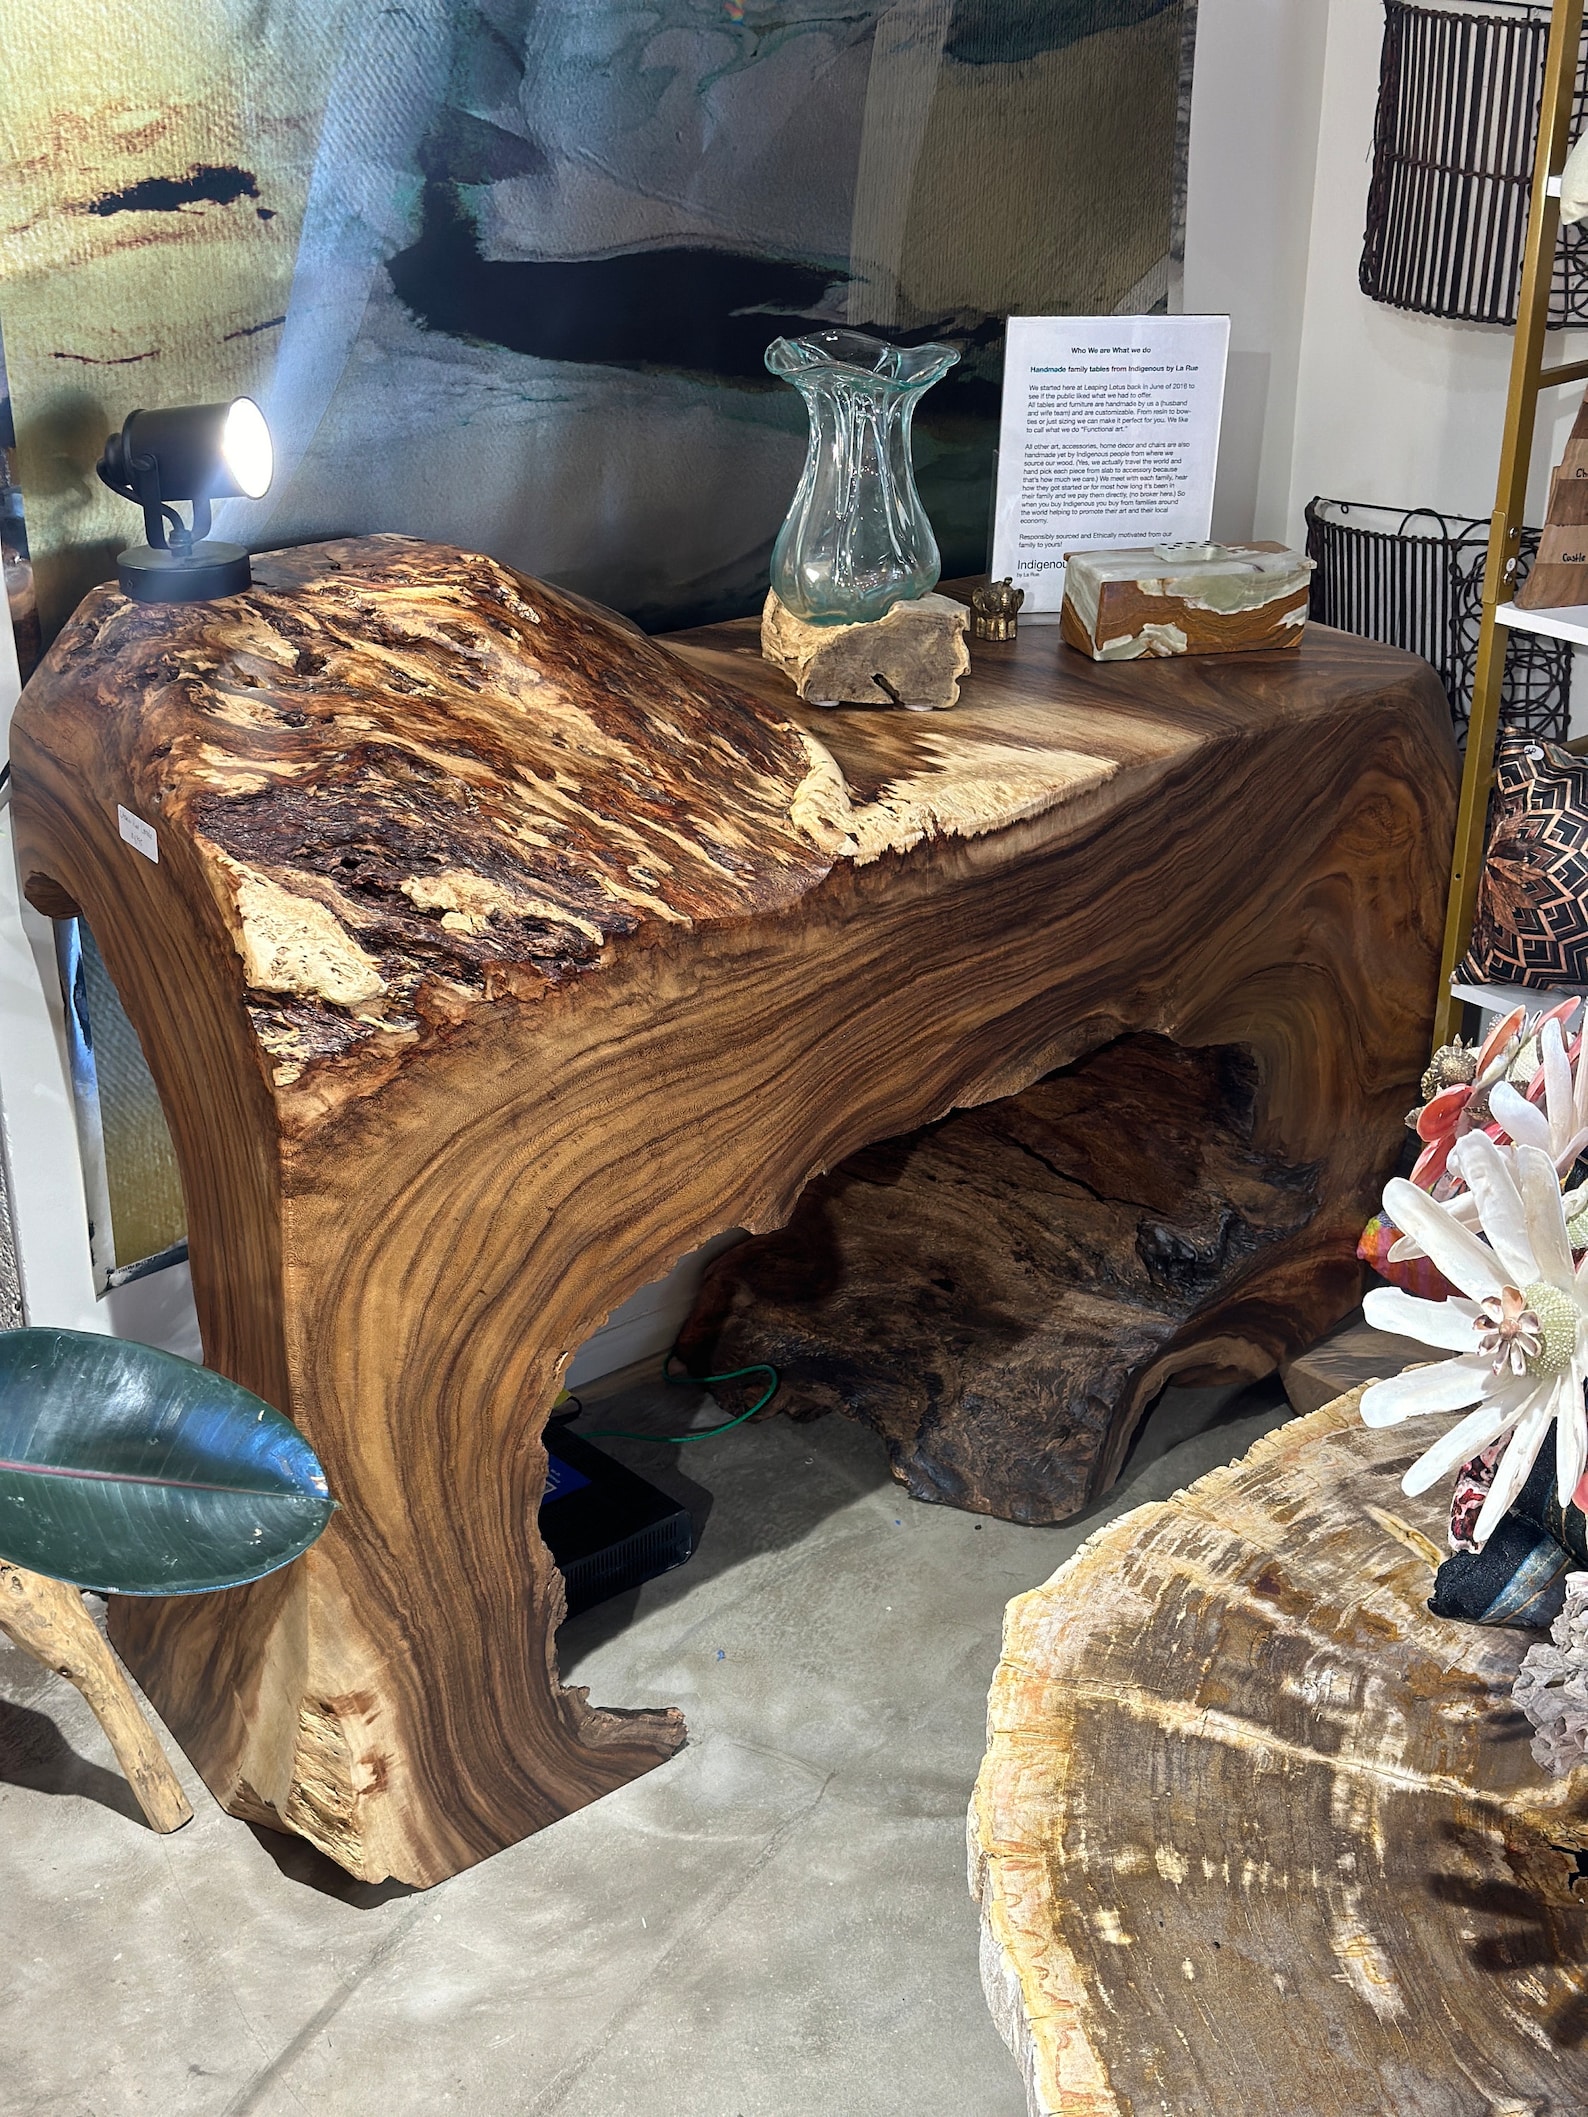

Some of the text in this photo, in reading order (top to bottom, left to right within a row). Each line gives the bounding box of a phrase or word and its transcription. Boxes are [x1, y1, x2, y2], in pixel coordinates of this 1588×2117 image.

[1067, 366, 1088, 374] family
[1128, 365, 1165, 373] Indigenous
[1165, 365, 1174, 373] by
[1017, 558, 1068, 572] Indigenou
